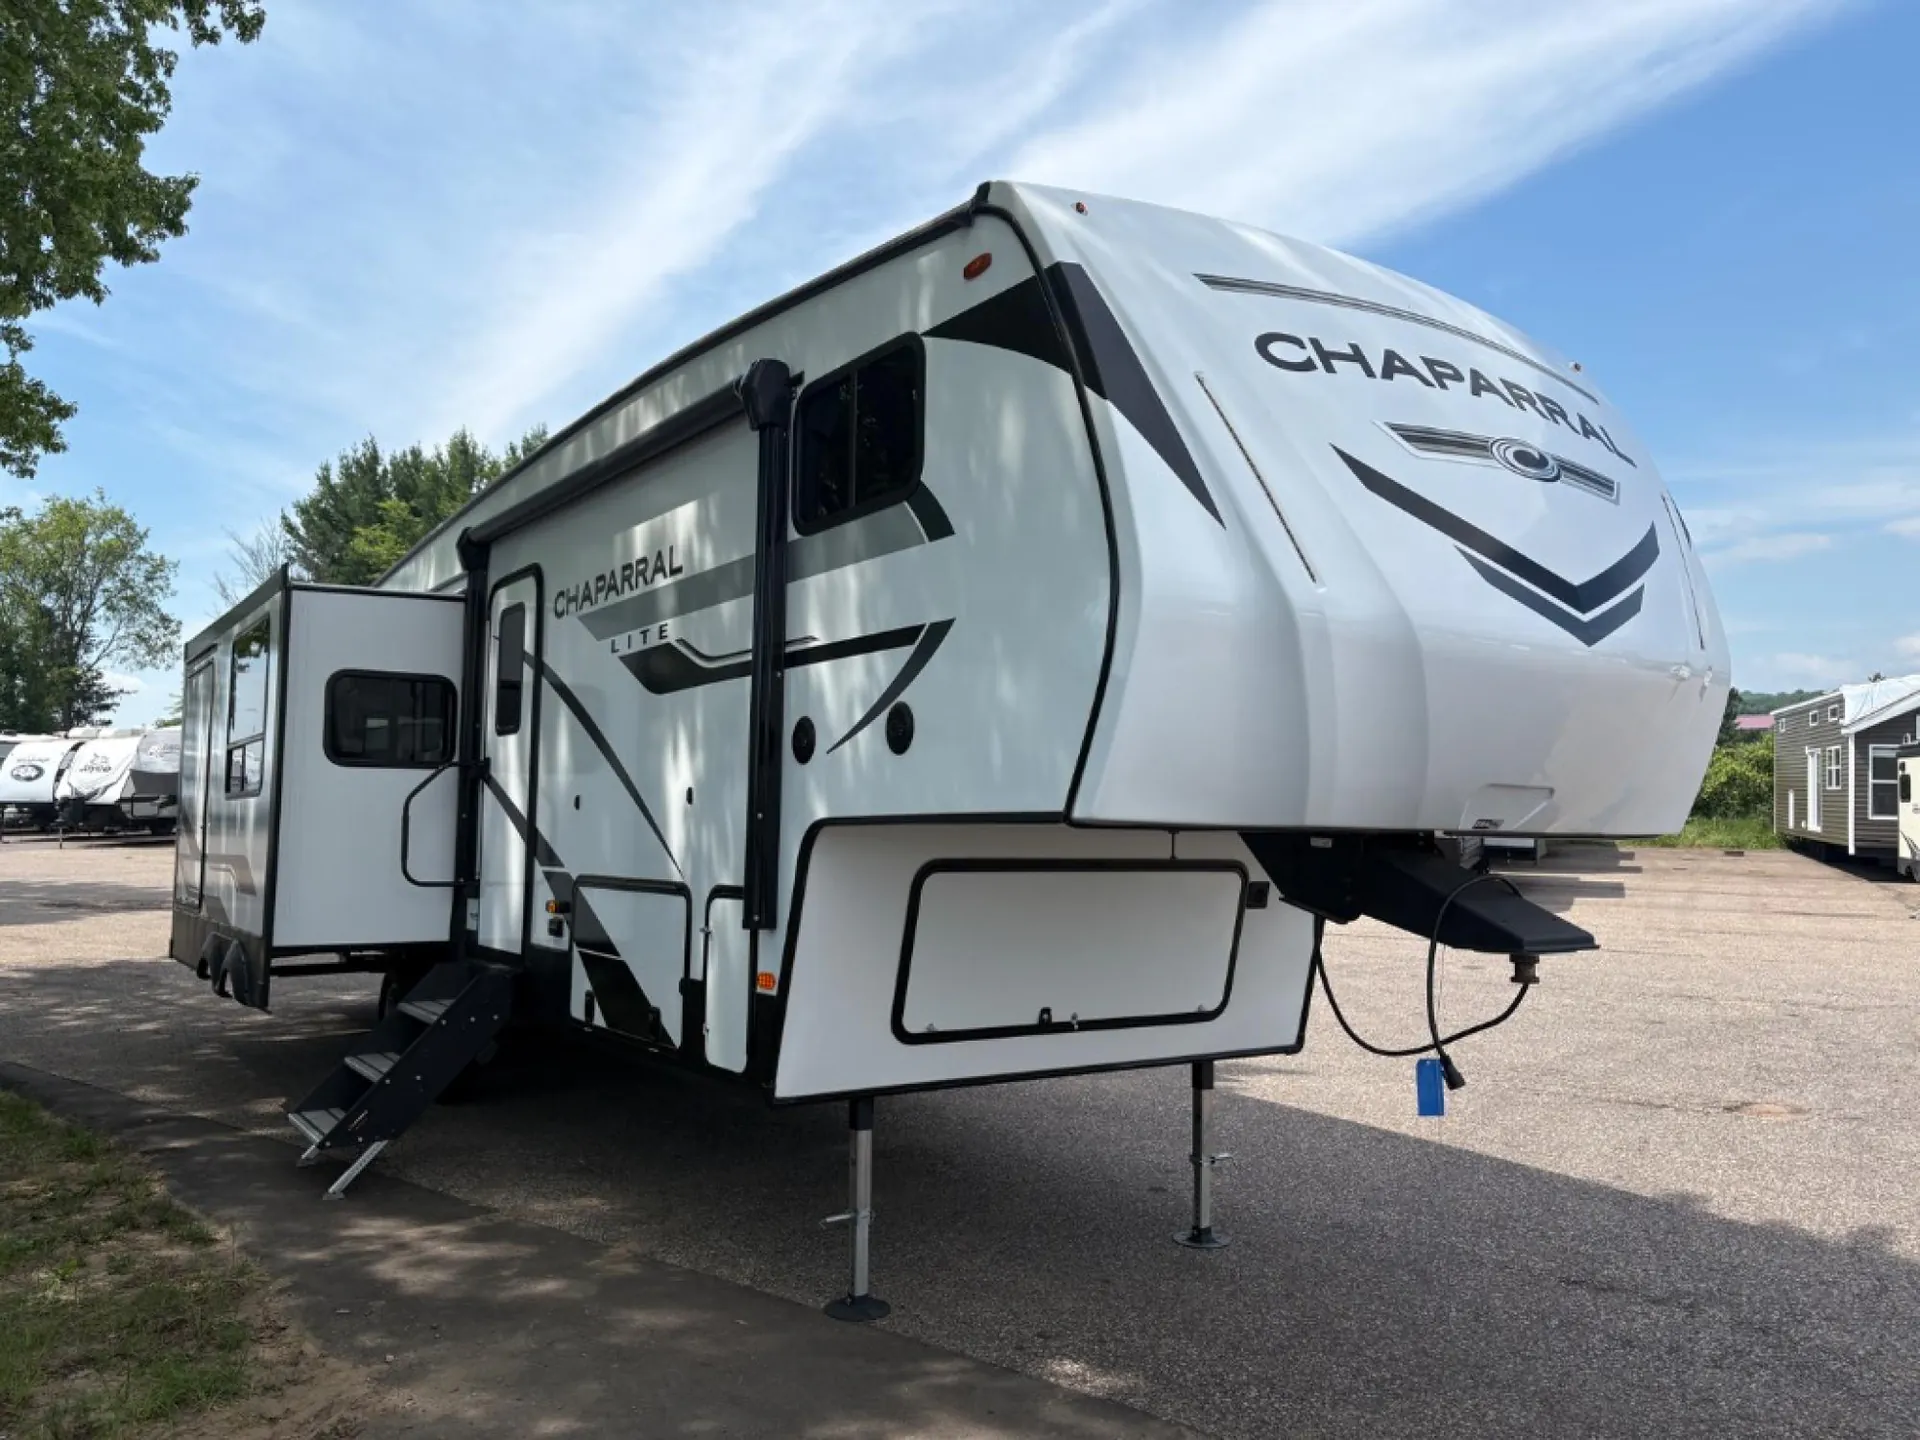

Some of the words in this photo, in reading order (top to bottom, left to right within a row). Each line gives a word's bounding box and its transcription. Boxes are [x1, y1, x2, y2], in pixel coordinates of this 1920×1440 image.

[1254, 332, 1637, 468] CHAPARRAL
[554, 545, 683, 619] CHAPARRAL
[611, 623, 668, 654] LITE
